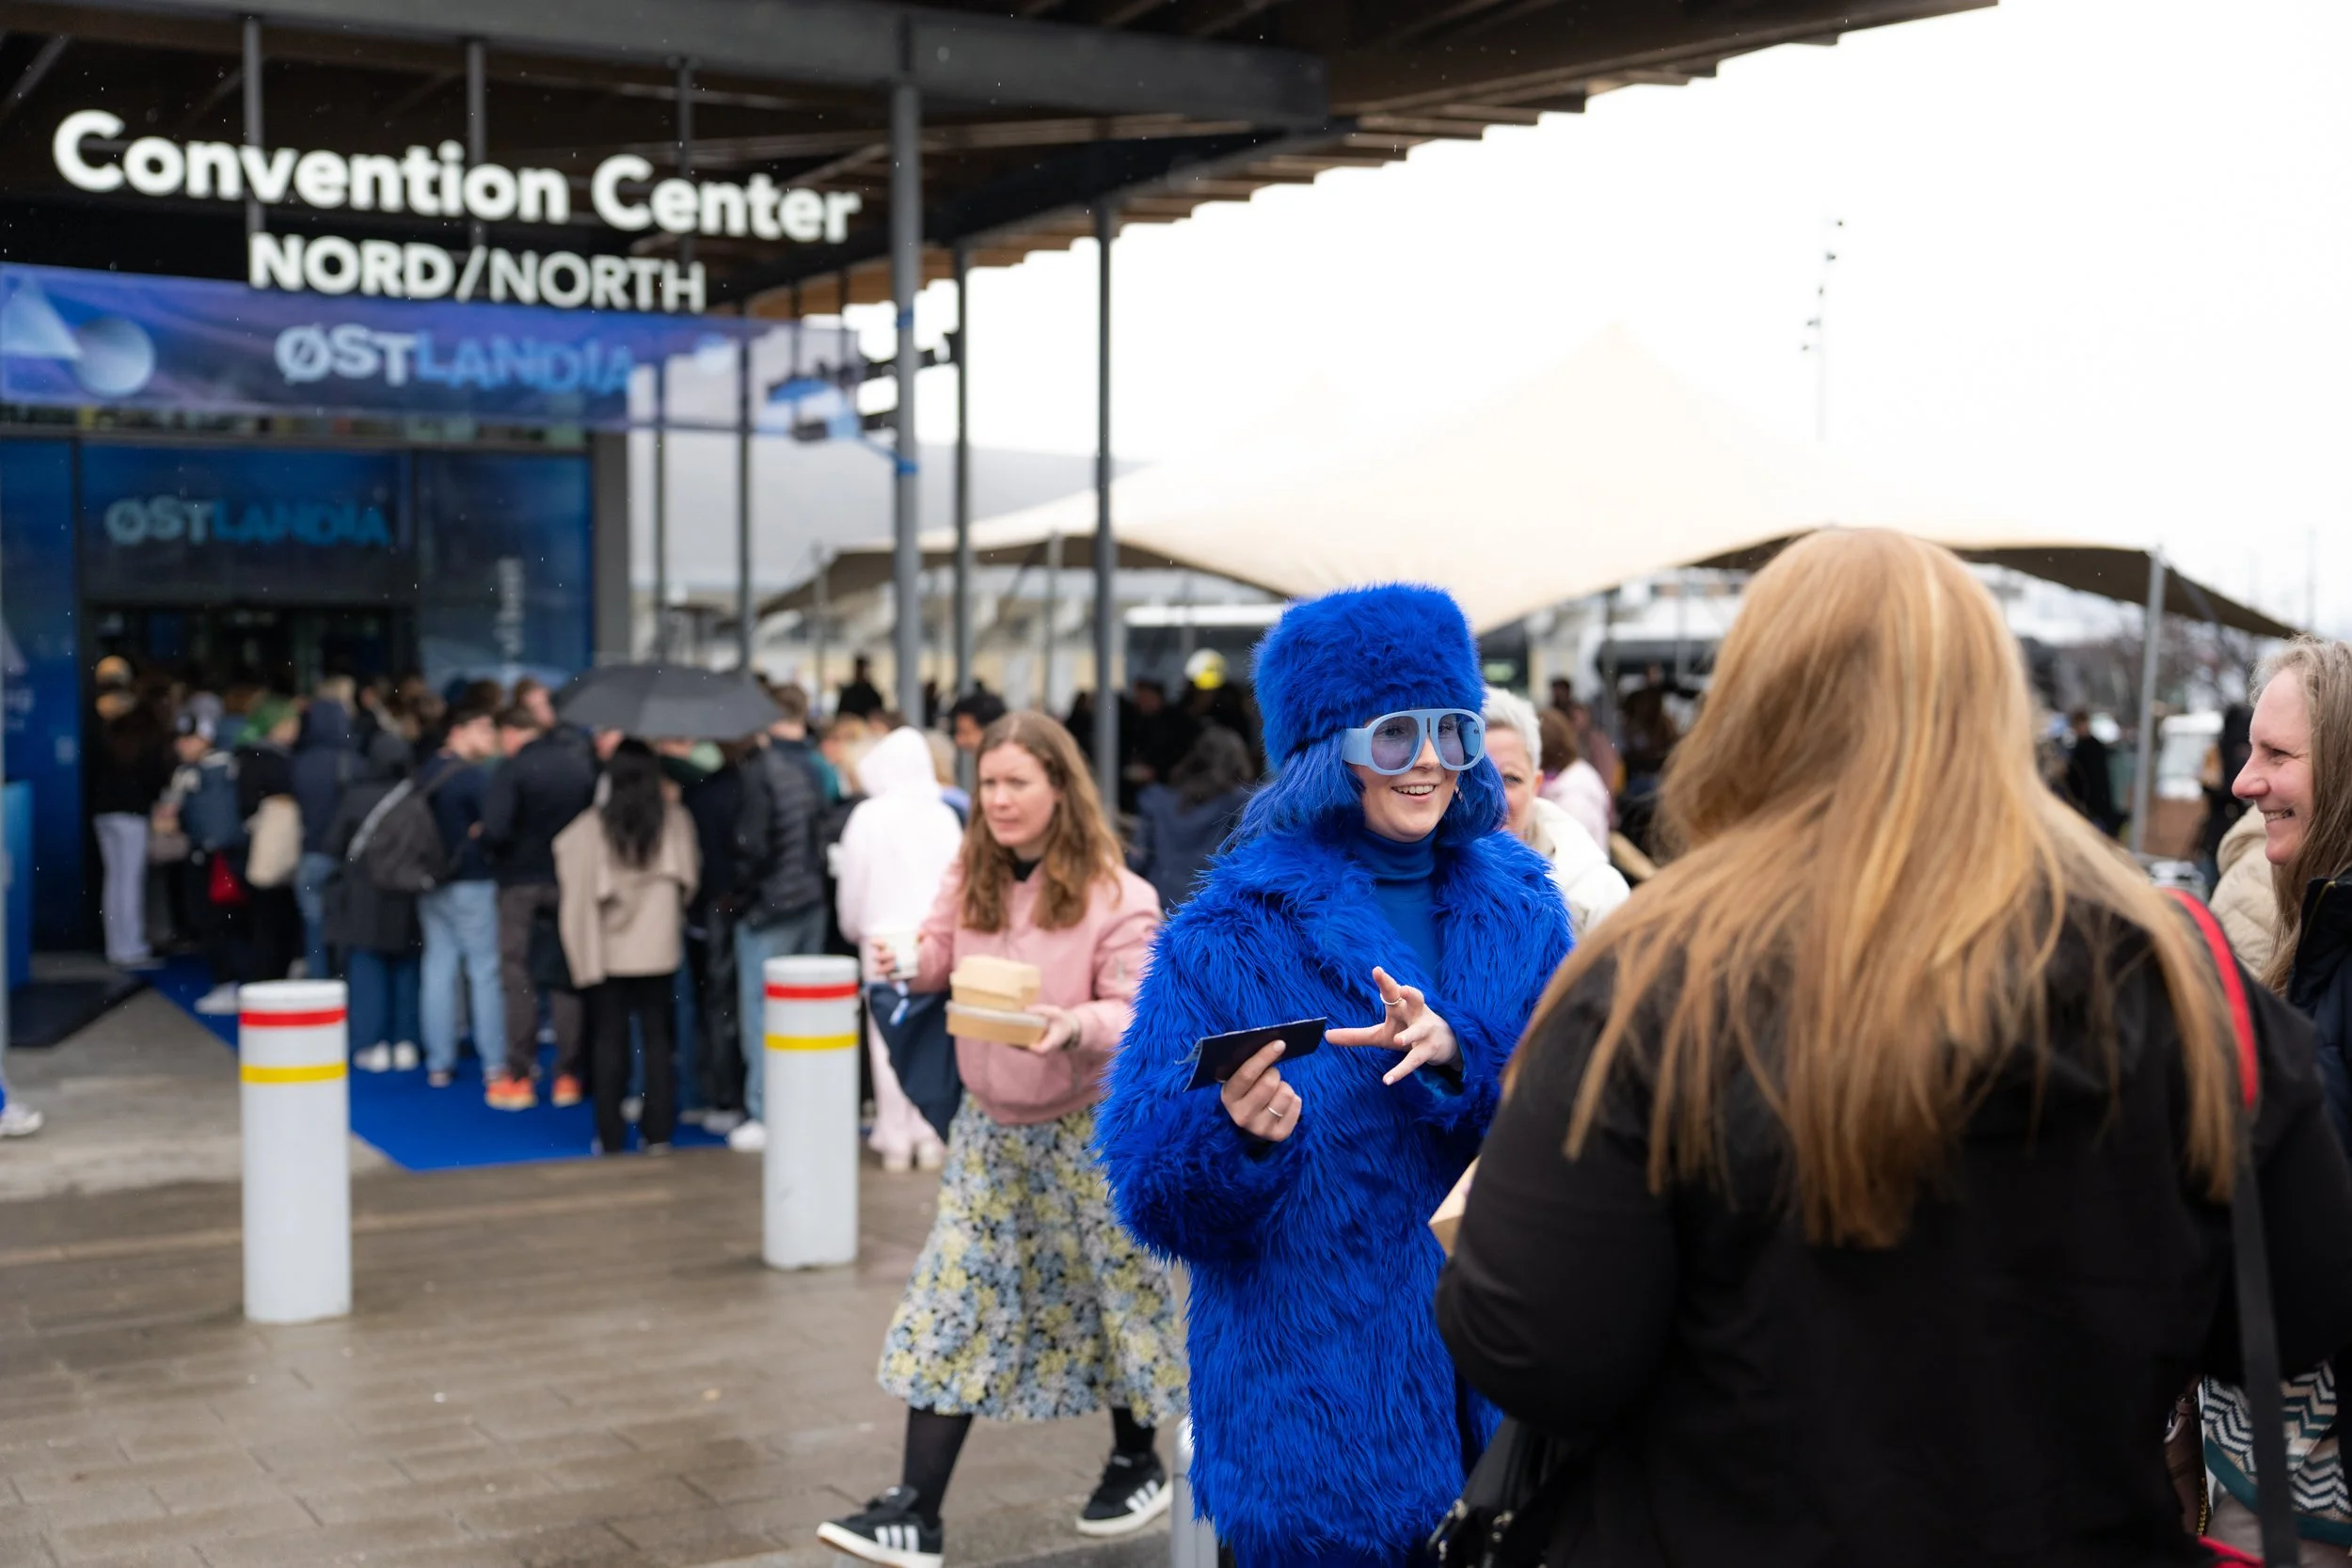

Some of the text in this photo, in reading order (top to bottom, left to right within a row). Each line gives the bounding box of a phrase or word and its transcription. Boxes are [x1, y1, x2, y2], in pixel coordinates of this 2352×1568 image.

[53, 109, 859, 243] Convention Center
[249, 233, 707, 313] NORD/NORTH
[276, 324, 636, 393] ØSTLANDIA
